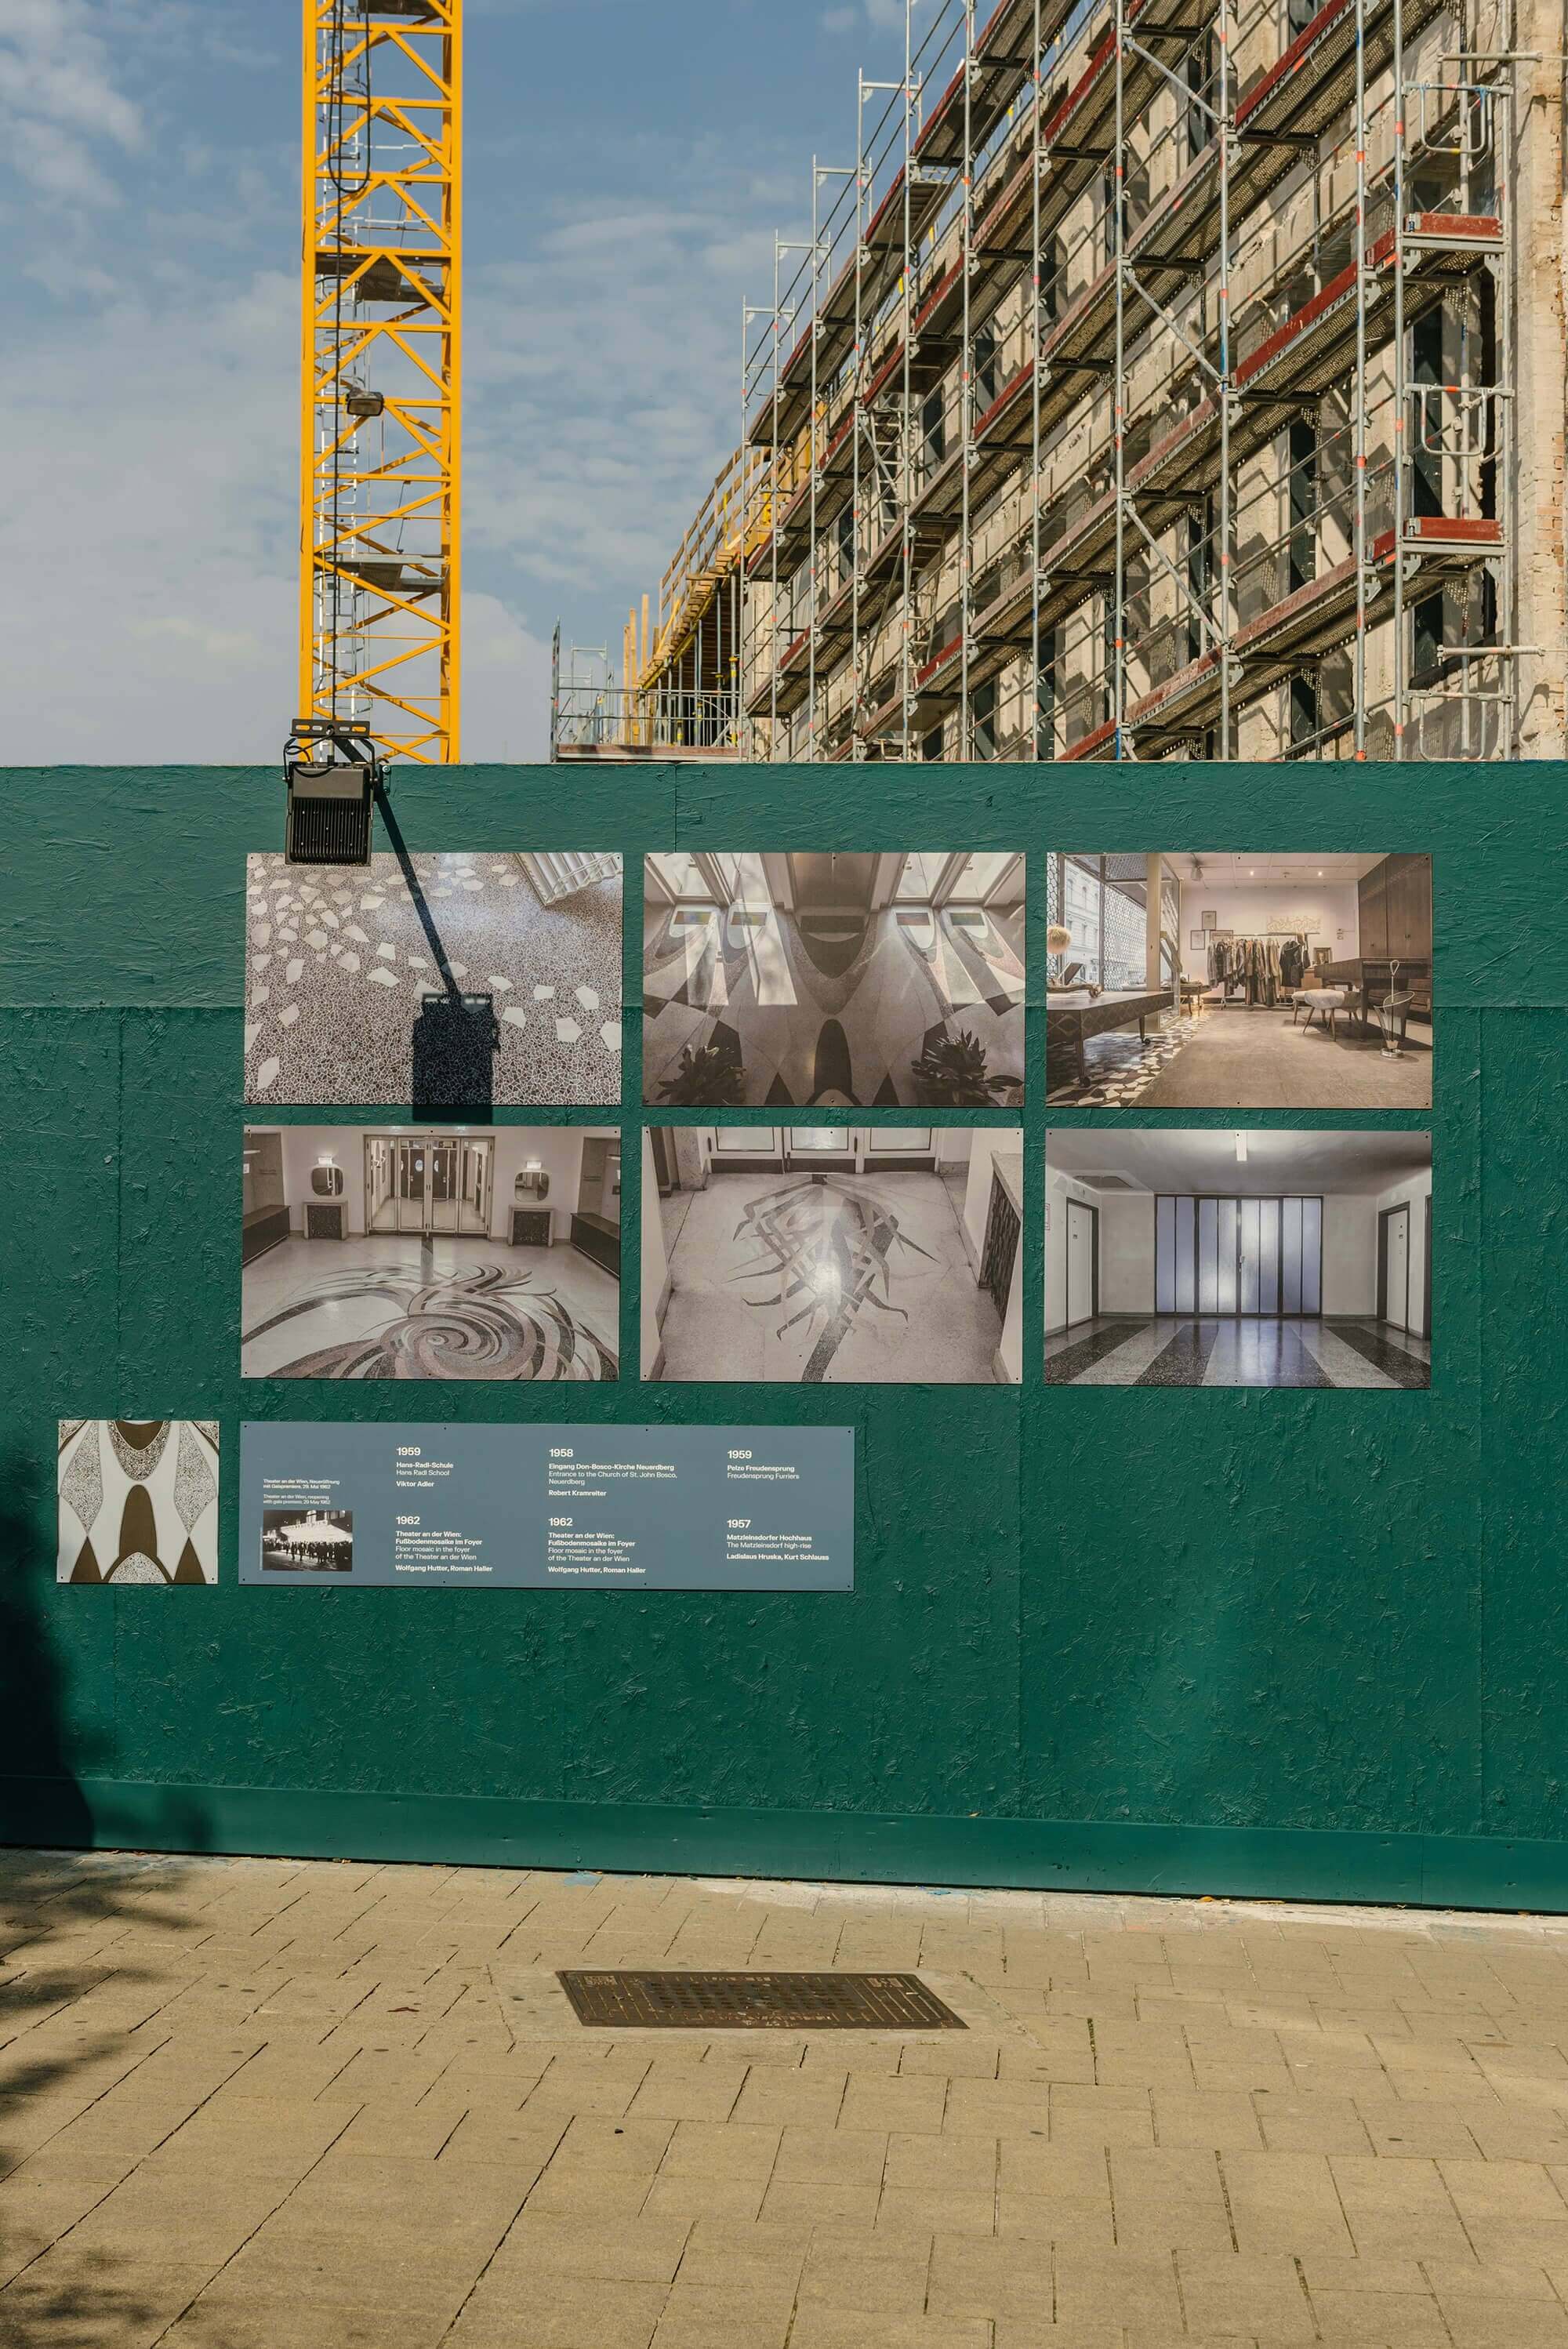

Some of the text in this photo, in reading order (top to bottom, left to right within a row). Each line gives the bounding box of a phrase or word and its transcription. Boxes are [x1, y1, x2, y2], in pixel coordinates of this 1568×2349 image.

[396, 1447, 421, 1456] 1959
[549, 1448, 574, 1457] 1958
[728, 1450, 752, 1459] 1959
[395, 1516, 420, 1525] 1962
[548, 1517, 573, 1527] 1962
[727, 1519, 751, 1528] 1957
